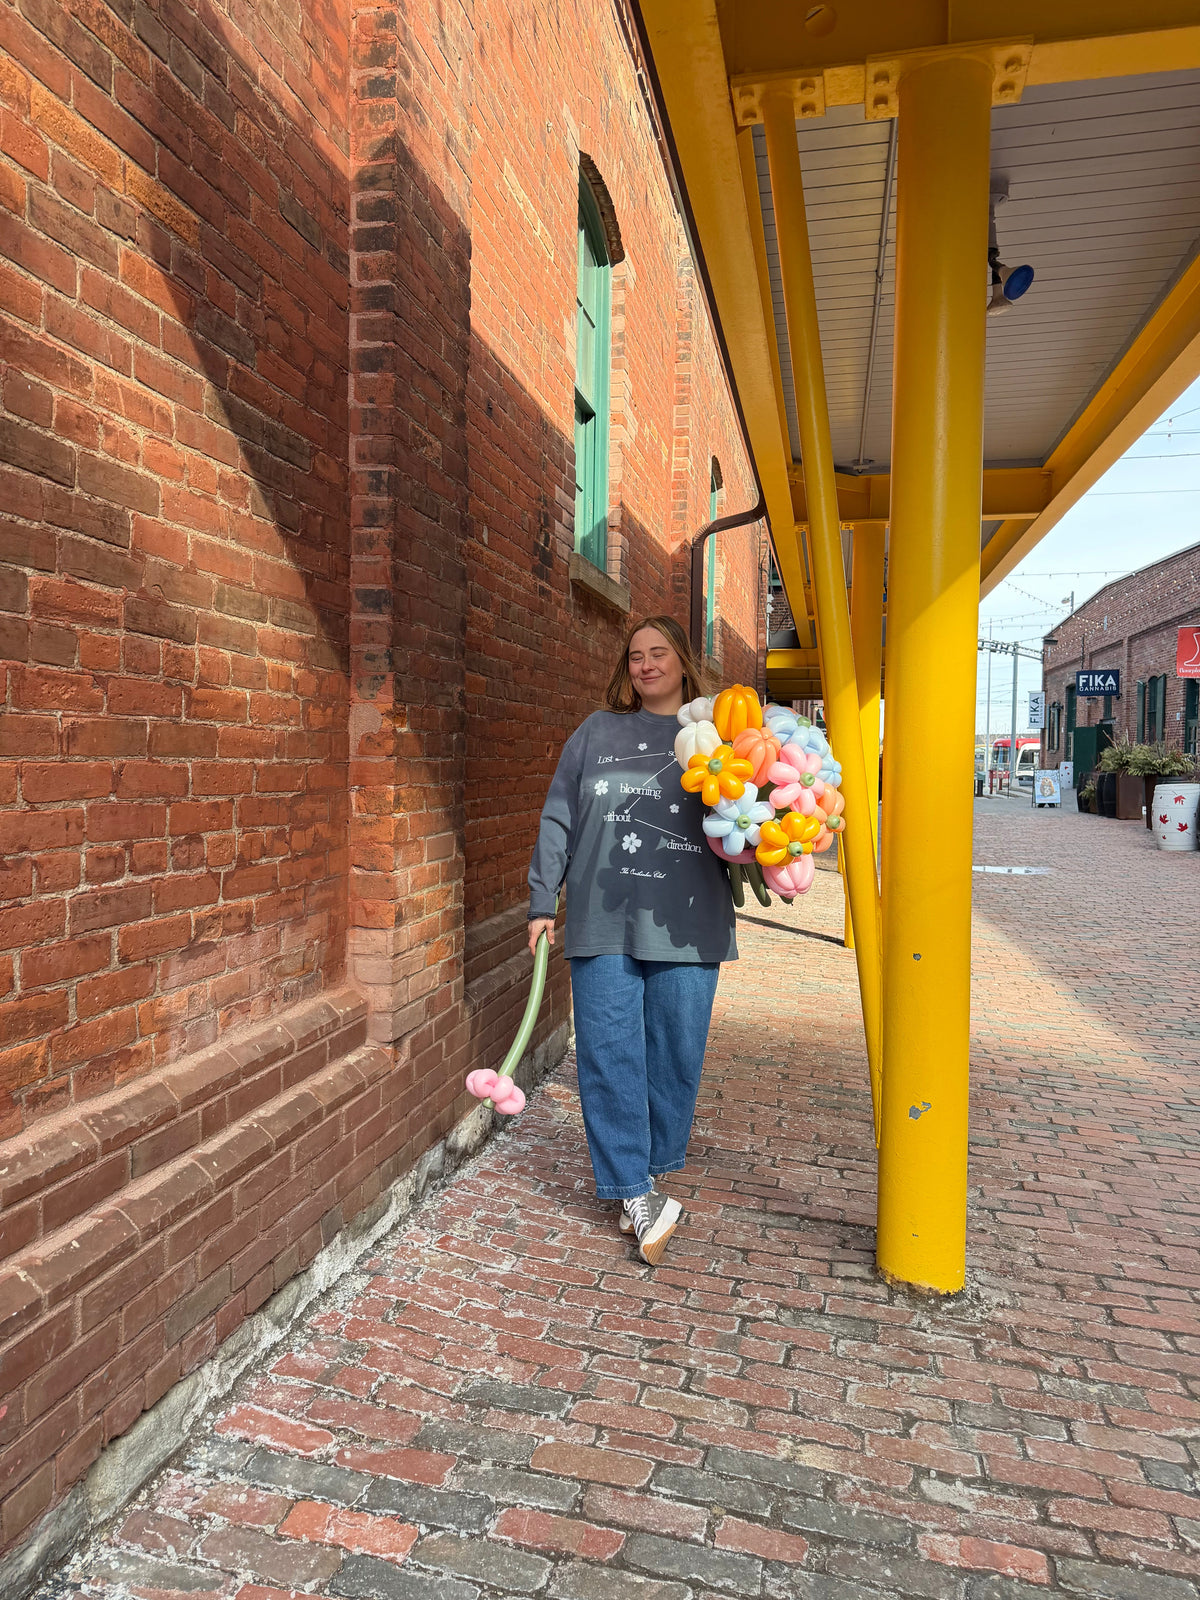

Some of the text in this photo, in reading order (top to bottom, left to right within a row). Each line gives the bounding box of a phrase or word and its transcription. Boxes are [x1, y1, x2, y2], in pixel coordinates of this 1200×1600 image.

[1079, 674, 1116, 687] FIKA
[1030, 697, 1040, 723] FIKA
[597, 755, 613, 764] Lost
[620, 783, 661, 800] blooming
[603, 810, 631, 822] without
